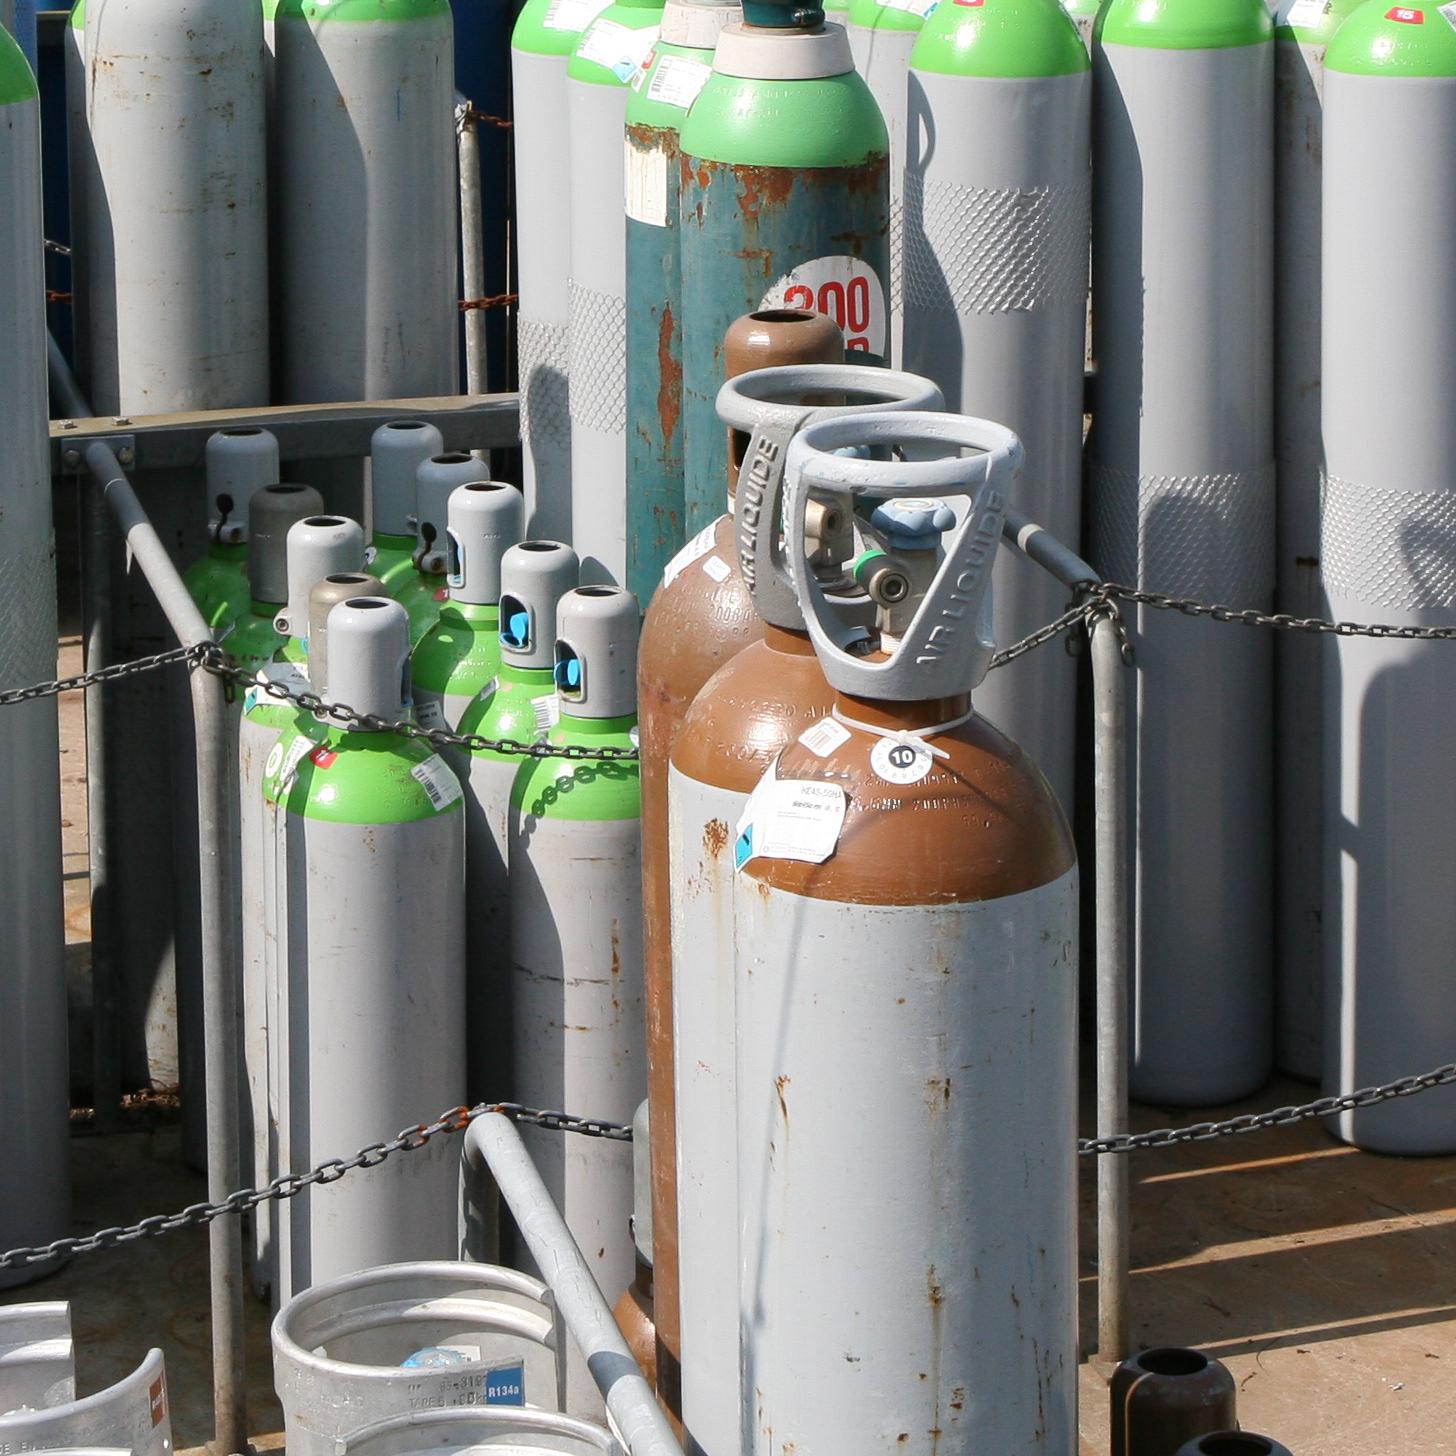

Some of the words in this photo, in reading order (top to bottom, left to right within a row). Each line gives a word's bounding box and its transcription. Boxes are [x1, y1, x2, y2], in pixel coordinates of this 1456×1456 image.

[1396, 9, 1415, 20] 15
[741, 434, 778, 551] LIQUIDE
[941, 489, 1003, 620] LIQUIDE
[892, 749, 914, 765] 10
[488, 1384, 519, 1398] R134a
